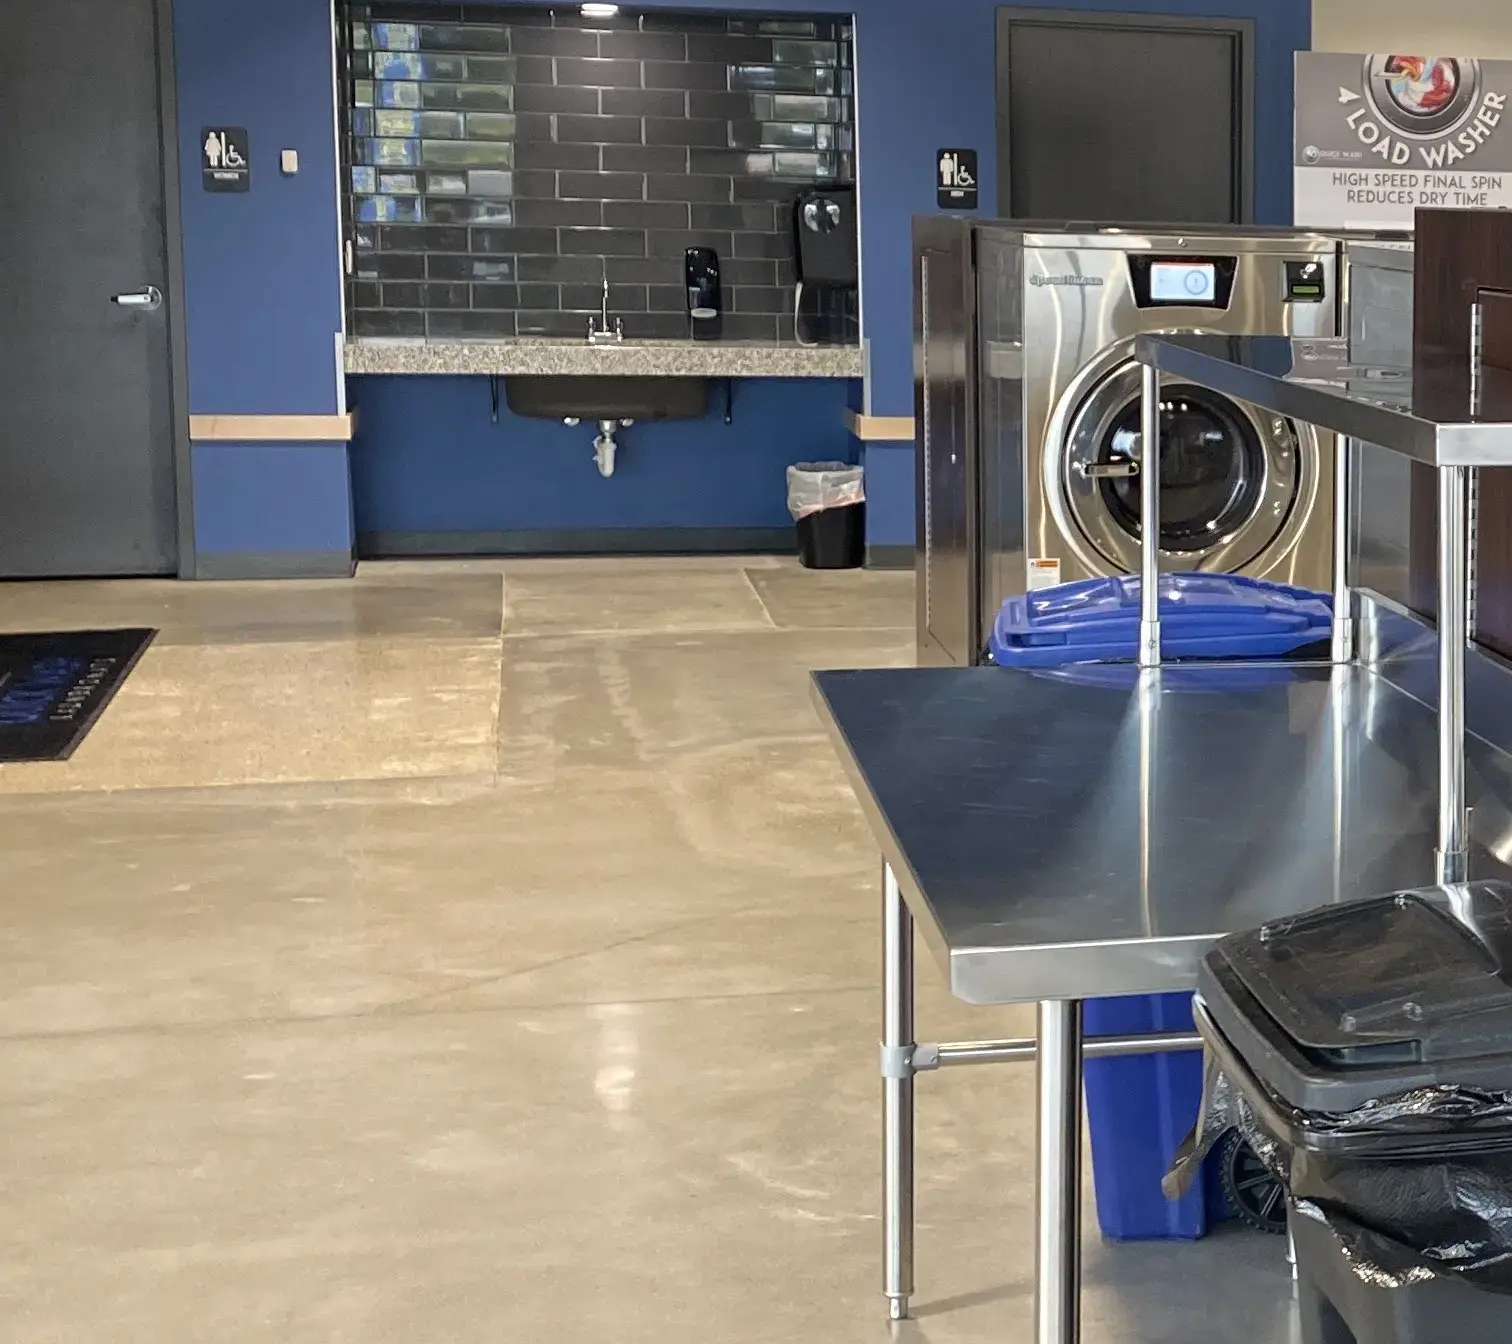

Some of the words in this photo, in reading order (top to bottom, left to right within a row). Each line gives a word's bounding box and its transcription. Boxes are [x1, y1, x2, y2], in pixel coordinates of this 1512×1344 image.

[1346, 108, 1410, 165] LOAD
[1418, 91, 1507, 168] WASHER
[1332, 172, 1369, 187] HIGH
[1374, 173, 1419, 188] SPEED
[1423, 175, 1466, 189] FINAL
[1471, 176, 1502, 190] SPIN
[1347, 189, 1414, 204] REDUCES
[1419, 191, 1449, 205] DRY
[1453, 192, 1488, 206] TIME
